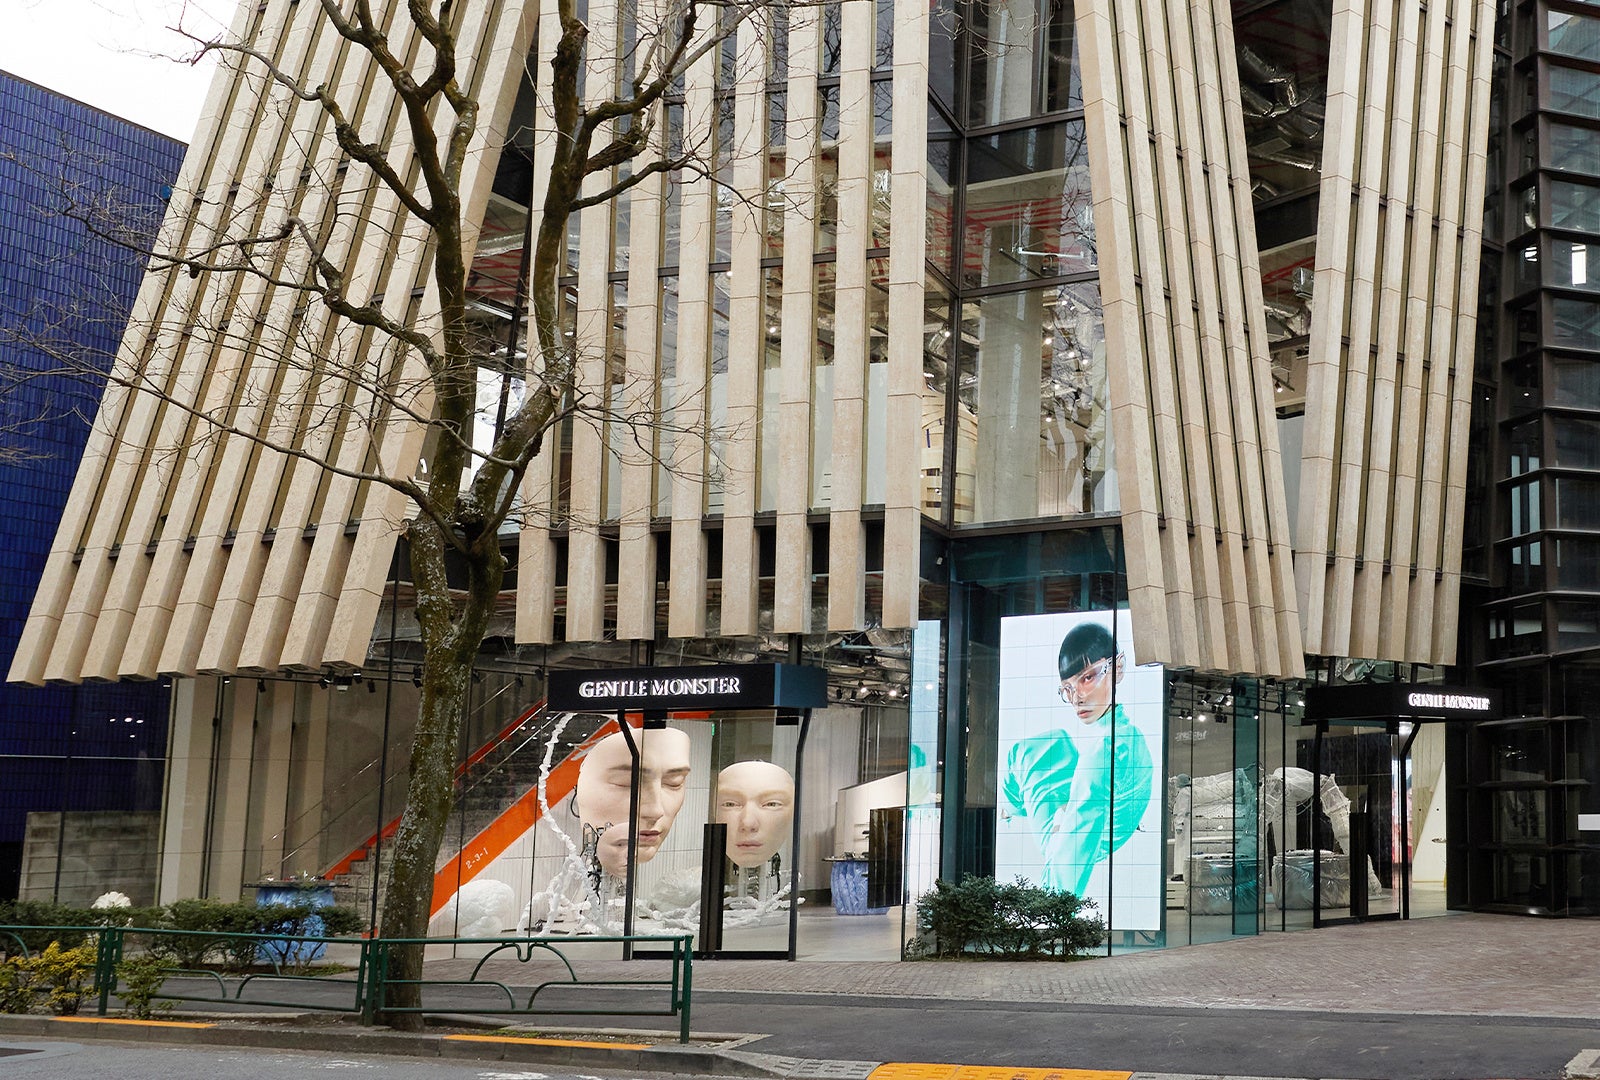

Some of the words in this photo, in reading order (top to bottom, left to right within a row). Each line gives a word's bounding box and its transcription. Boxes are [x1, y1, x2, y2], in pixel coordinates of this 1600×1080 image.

[579, 680, 648, 698] GENTLE
[650, 677, 741, 696] MONSTER
[465, 847, 489, 869] 2-3-1
